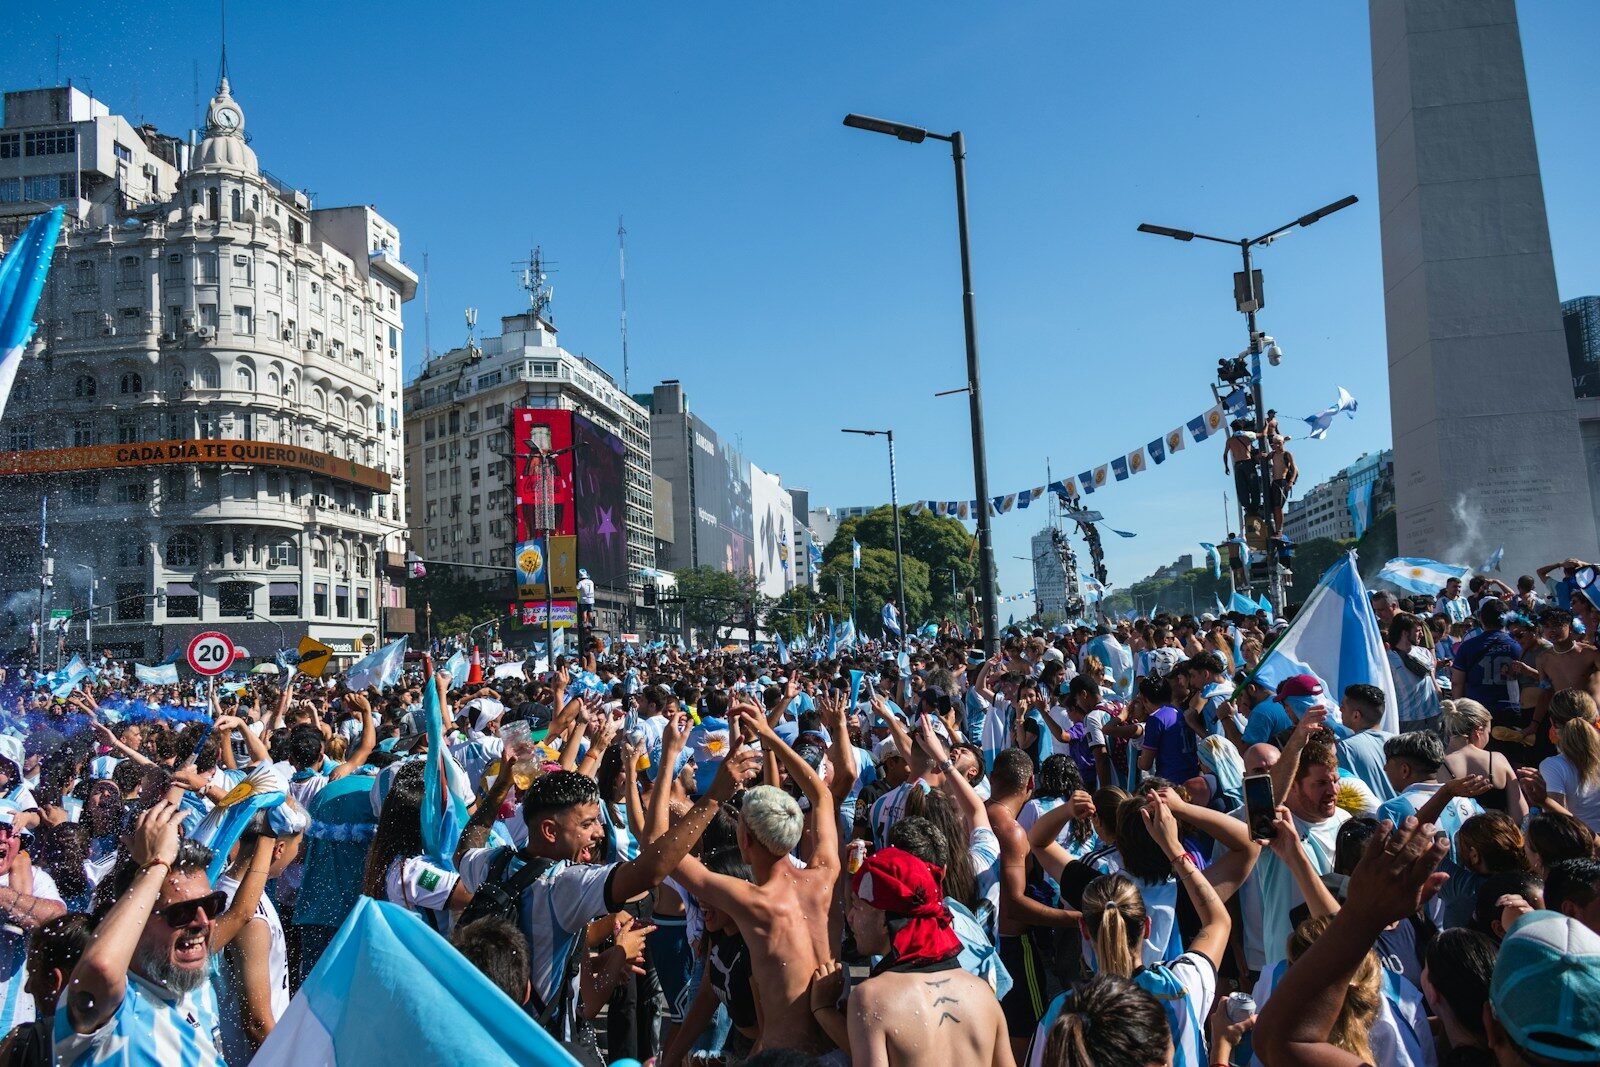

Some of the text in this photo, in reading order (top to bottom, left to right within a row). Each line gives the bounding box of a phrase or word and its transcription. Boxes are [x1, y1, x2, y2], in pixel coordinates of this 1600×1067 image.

[116, 446, 165, 463] CADA
[168, 441, 199, 458] DÍA
[204, 444, 227, 458] TE
[231, 442, 296, 463] QUIERO
[198, 644, 225, 662] 20
[1478, 655, 1513, 686] 10
